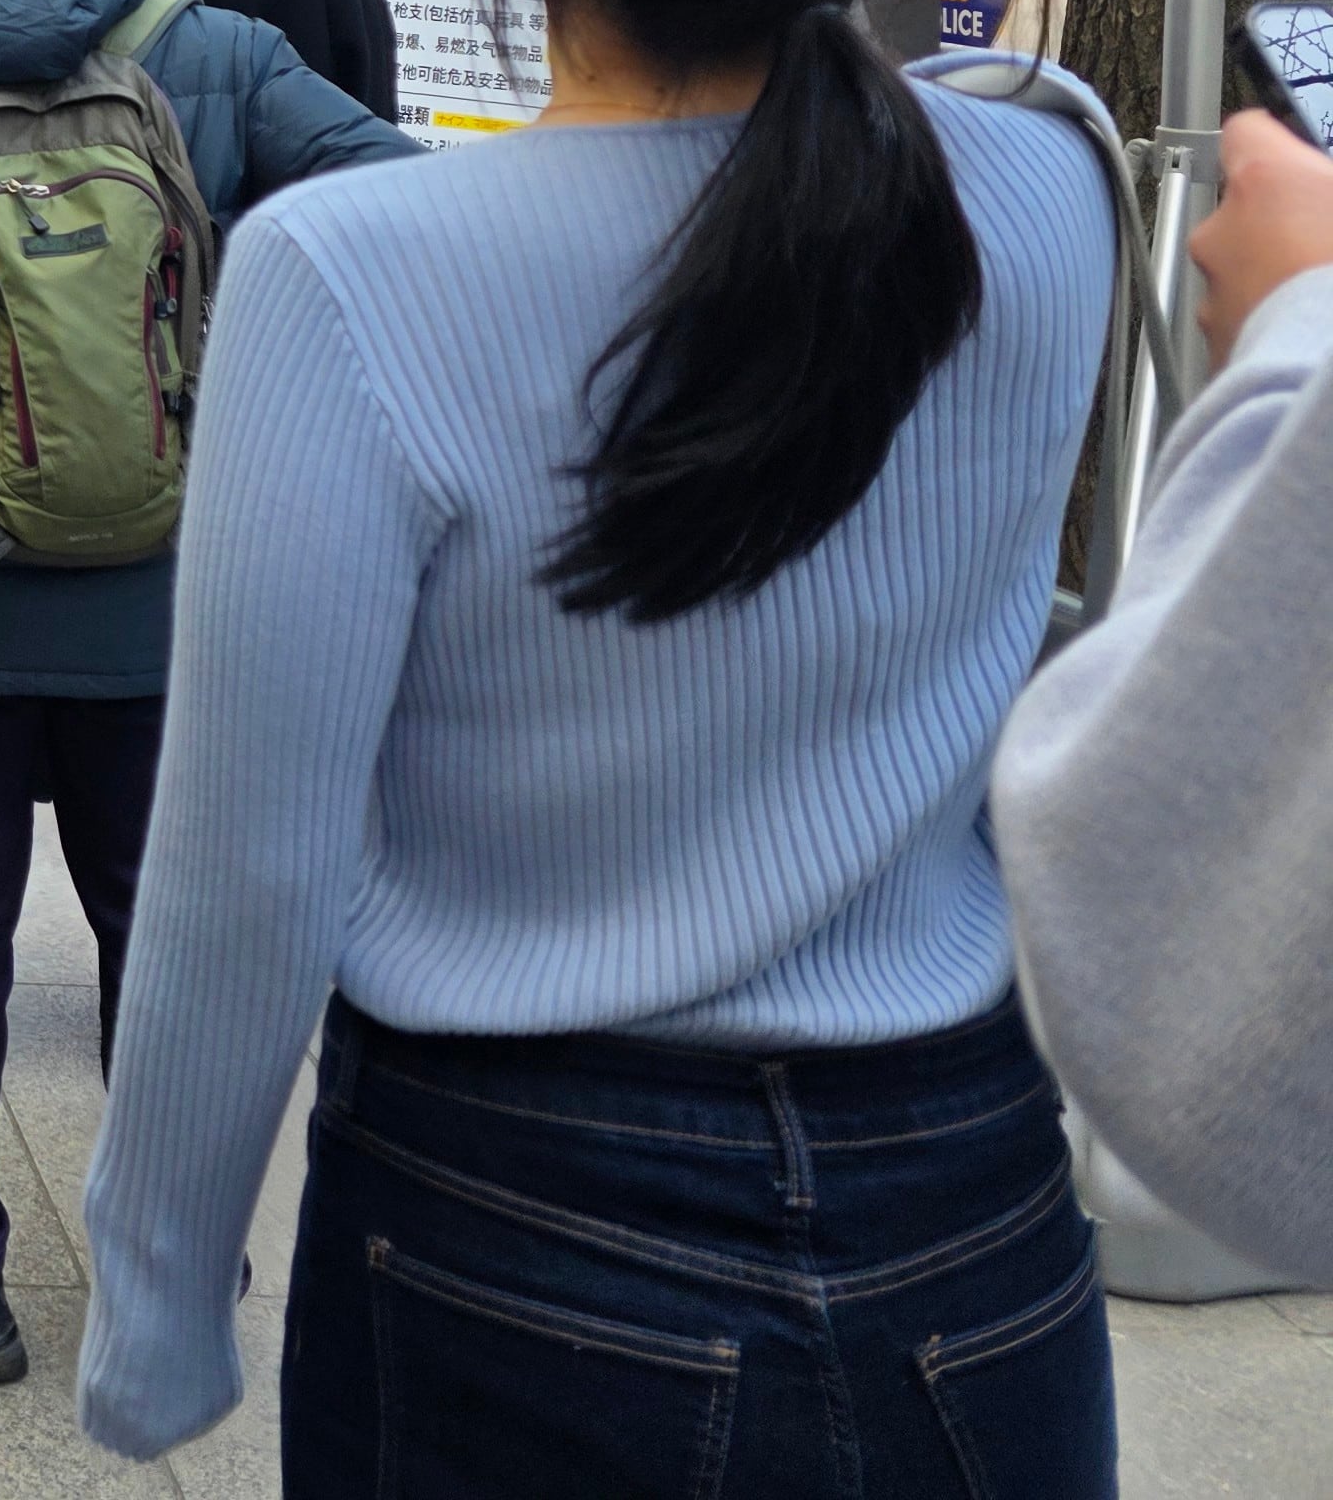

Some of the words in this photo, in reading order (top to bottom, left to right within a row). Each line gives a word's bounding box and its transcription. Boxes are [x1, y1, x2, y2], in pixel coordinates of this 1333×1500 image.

[389, 1, 525, 30] 枪支(包括仿真具
[941, 7, 984, 38] LICE
